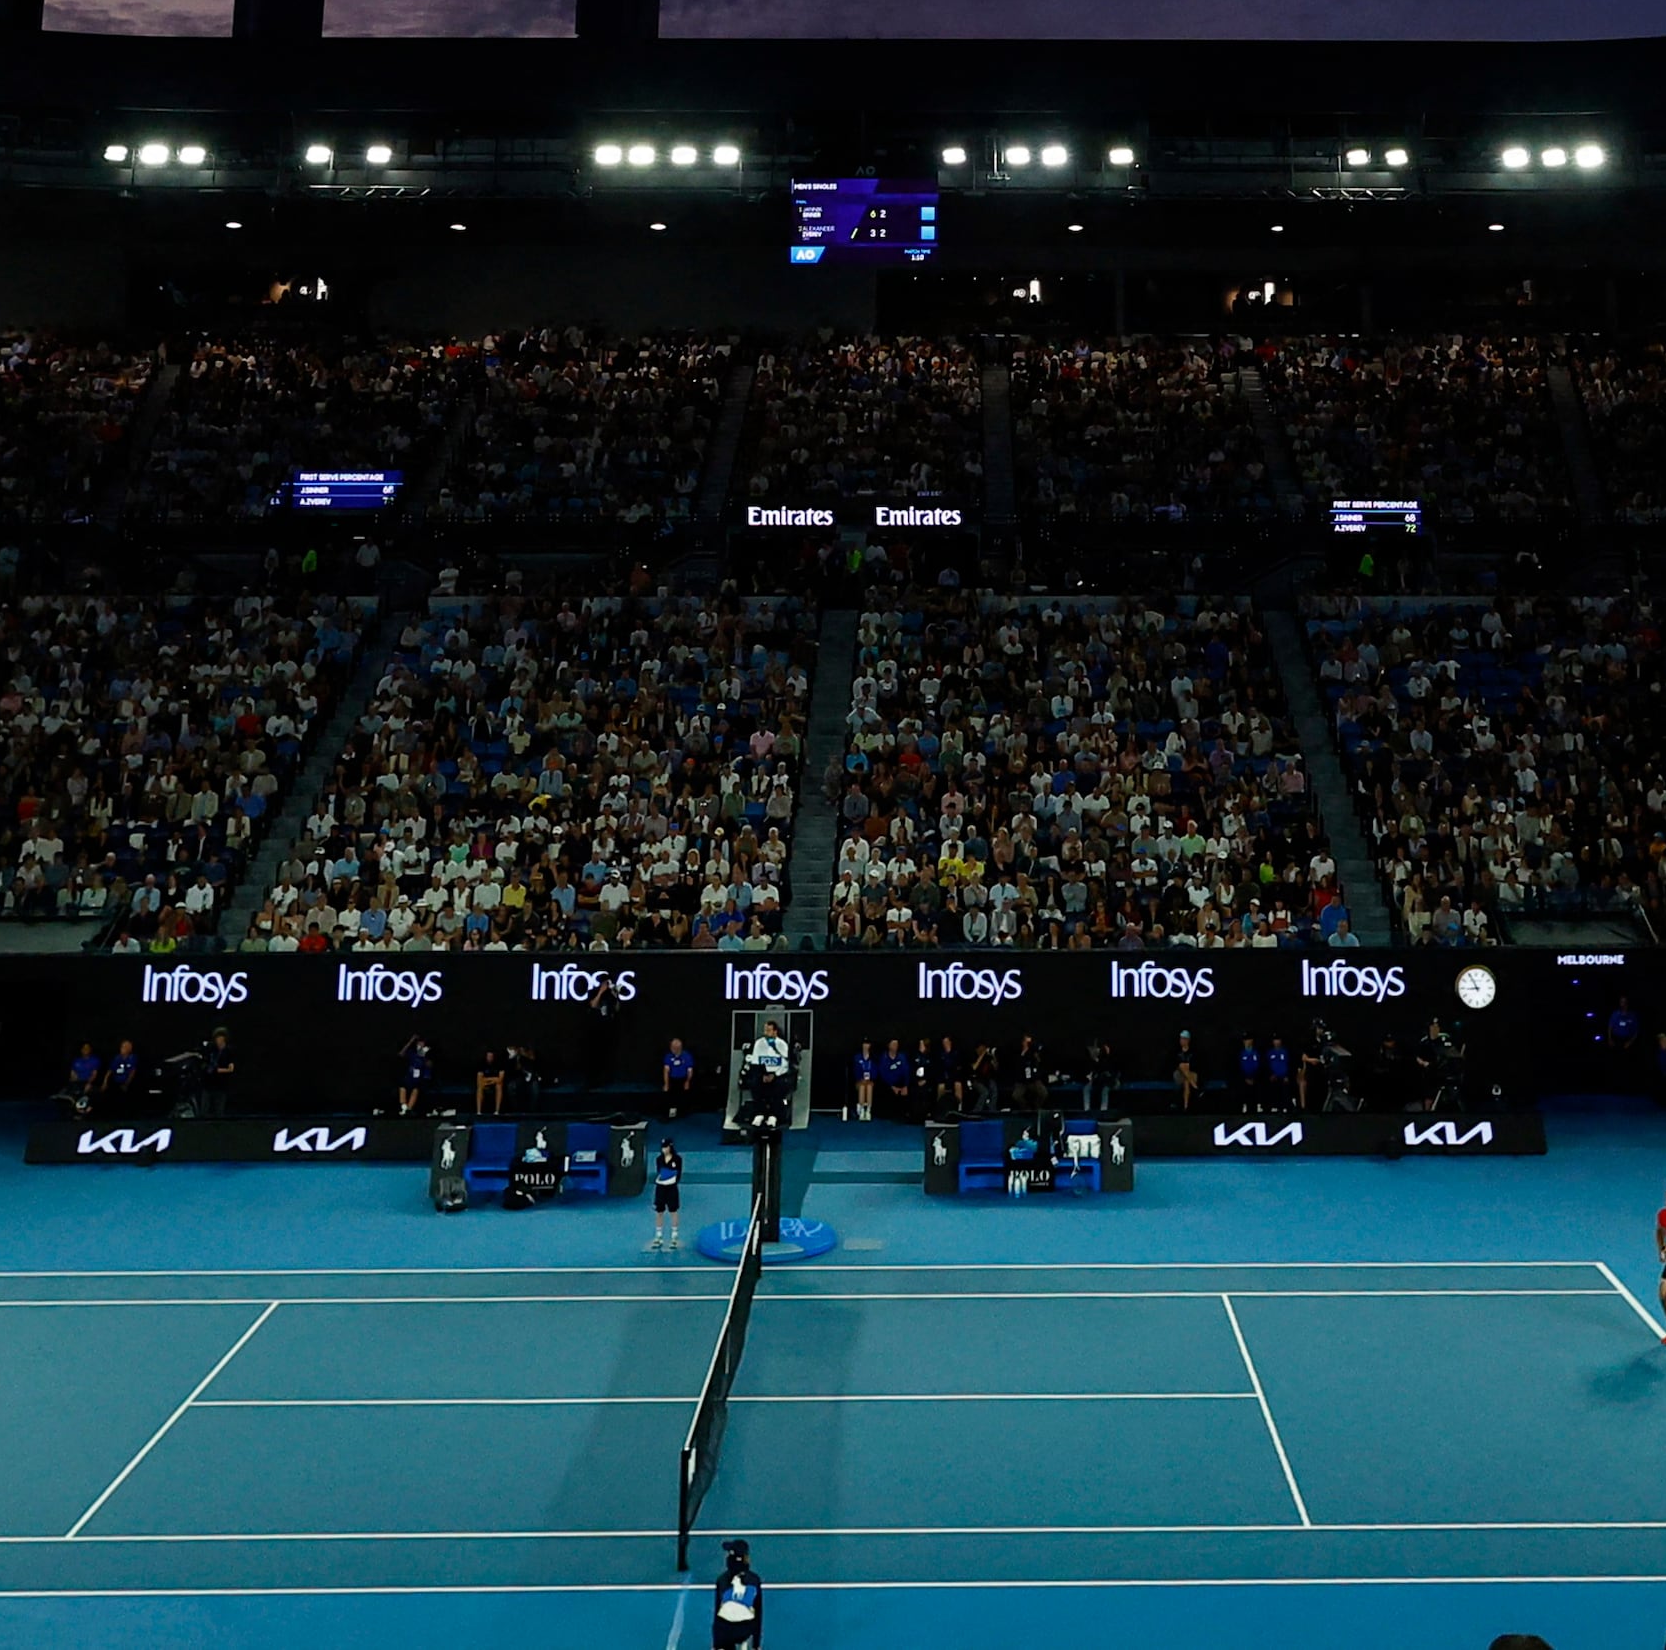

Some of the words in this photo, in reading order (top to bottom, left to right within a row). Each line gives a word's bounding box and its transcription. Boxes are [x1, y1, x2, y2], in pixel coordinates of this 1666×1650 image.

[870, 210, 876, 218] 6
[880, 210, 886, 218] 2
[870, 229, 876, 237] 3
[880, 229, 886, 237] 2
[796, 250, 815, 260] AO
[747, 506, 833, 526] Emirates
[875, 506, 962, 526] Emirates
[1404, 513, 1416, 522] 68
[1405, 524, 1416, 533] 72
[1557, 955, 1624, 965] MELBOURNE
[143, 964, 247, 1008] Infosys
[337, 963, 442, 1007] Infosys
[725, 962, 829, 1006] Infosys
[918, 961, 1022, 1005] Infosys
[1111, 960, 1215, 1004] Infosys
[1302, 959, 1406, 1003] Infosys
[77, 1128, 172, 1154] KIA
[273, 1127, 367, 1152] KIA
[1213, 1122, 1303, 1146] KIA
[1403, 1121, 1493, 1145] KIA
[515, 1173, 556, 1185] POLO
